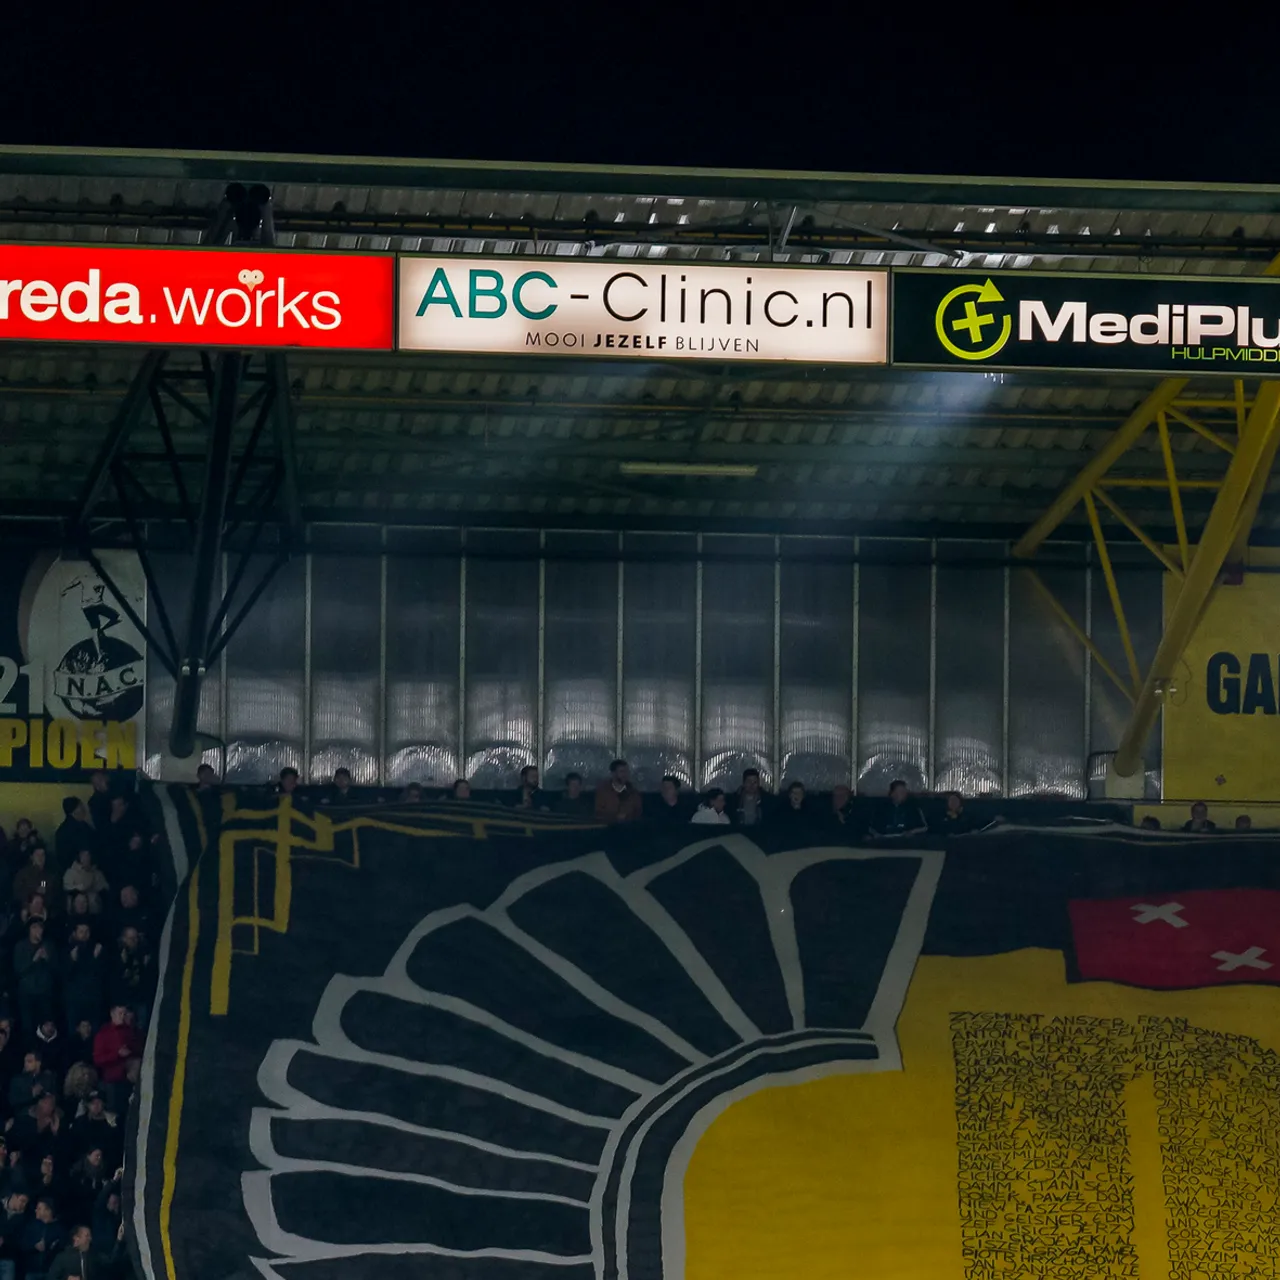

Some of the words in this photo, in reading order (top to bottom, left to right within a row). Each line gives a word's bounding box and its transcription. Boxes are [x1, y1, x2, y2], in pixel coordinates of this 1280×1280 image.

[415, 267, 874, 330] ABC-Clinic.nl
[526, 331, 586, 348] MOOI
[594, 333, 667, 351] JEZELF
[676, 336, 760, 354] BLIJVEN
